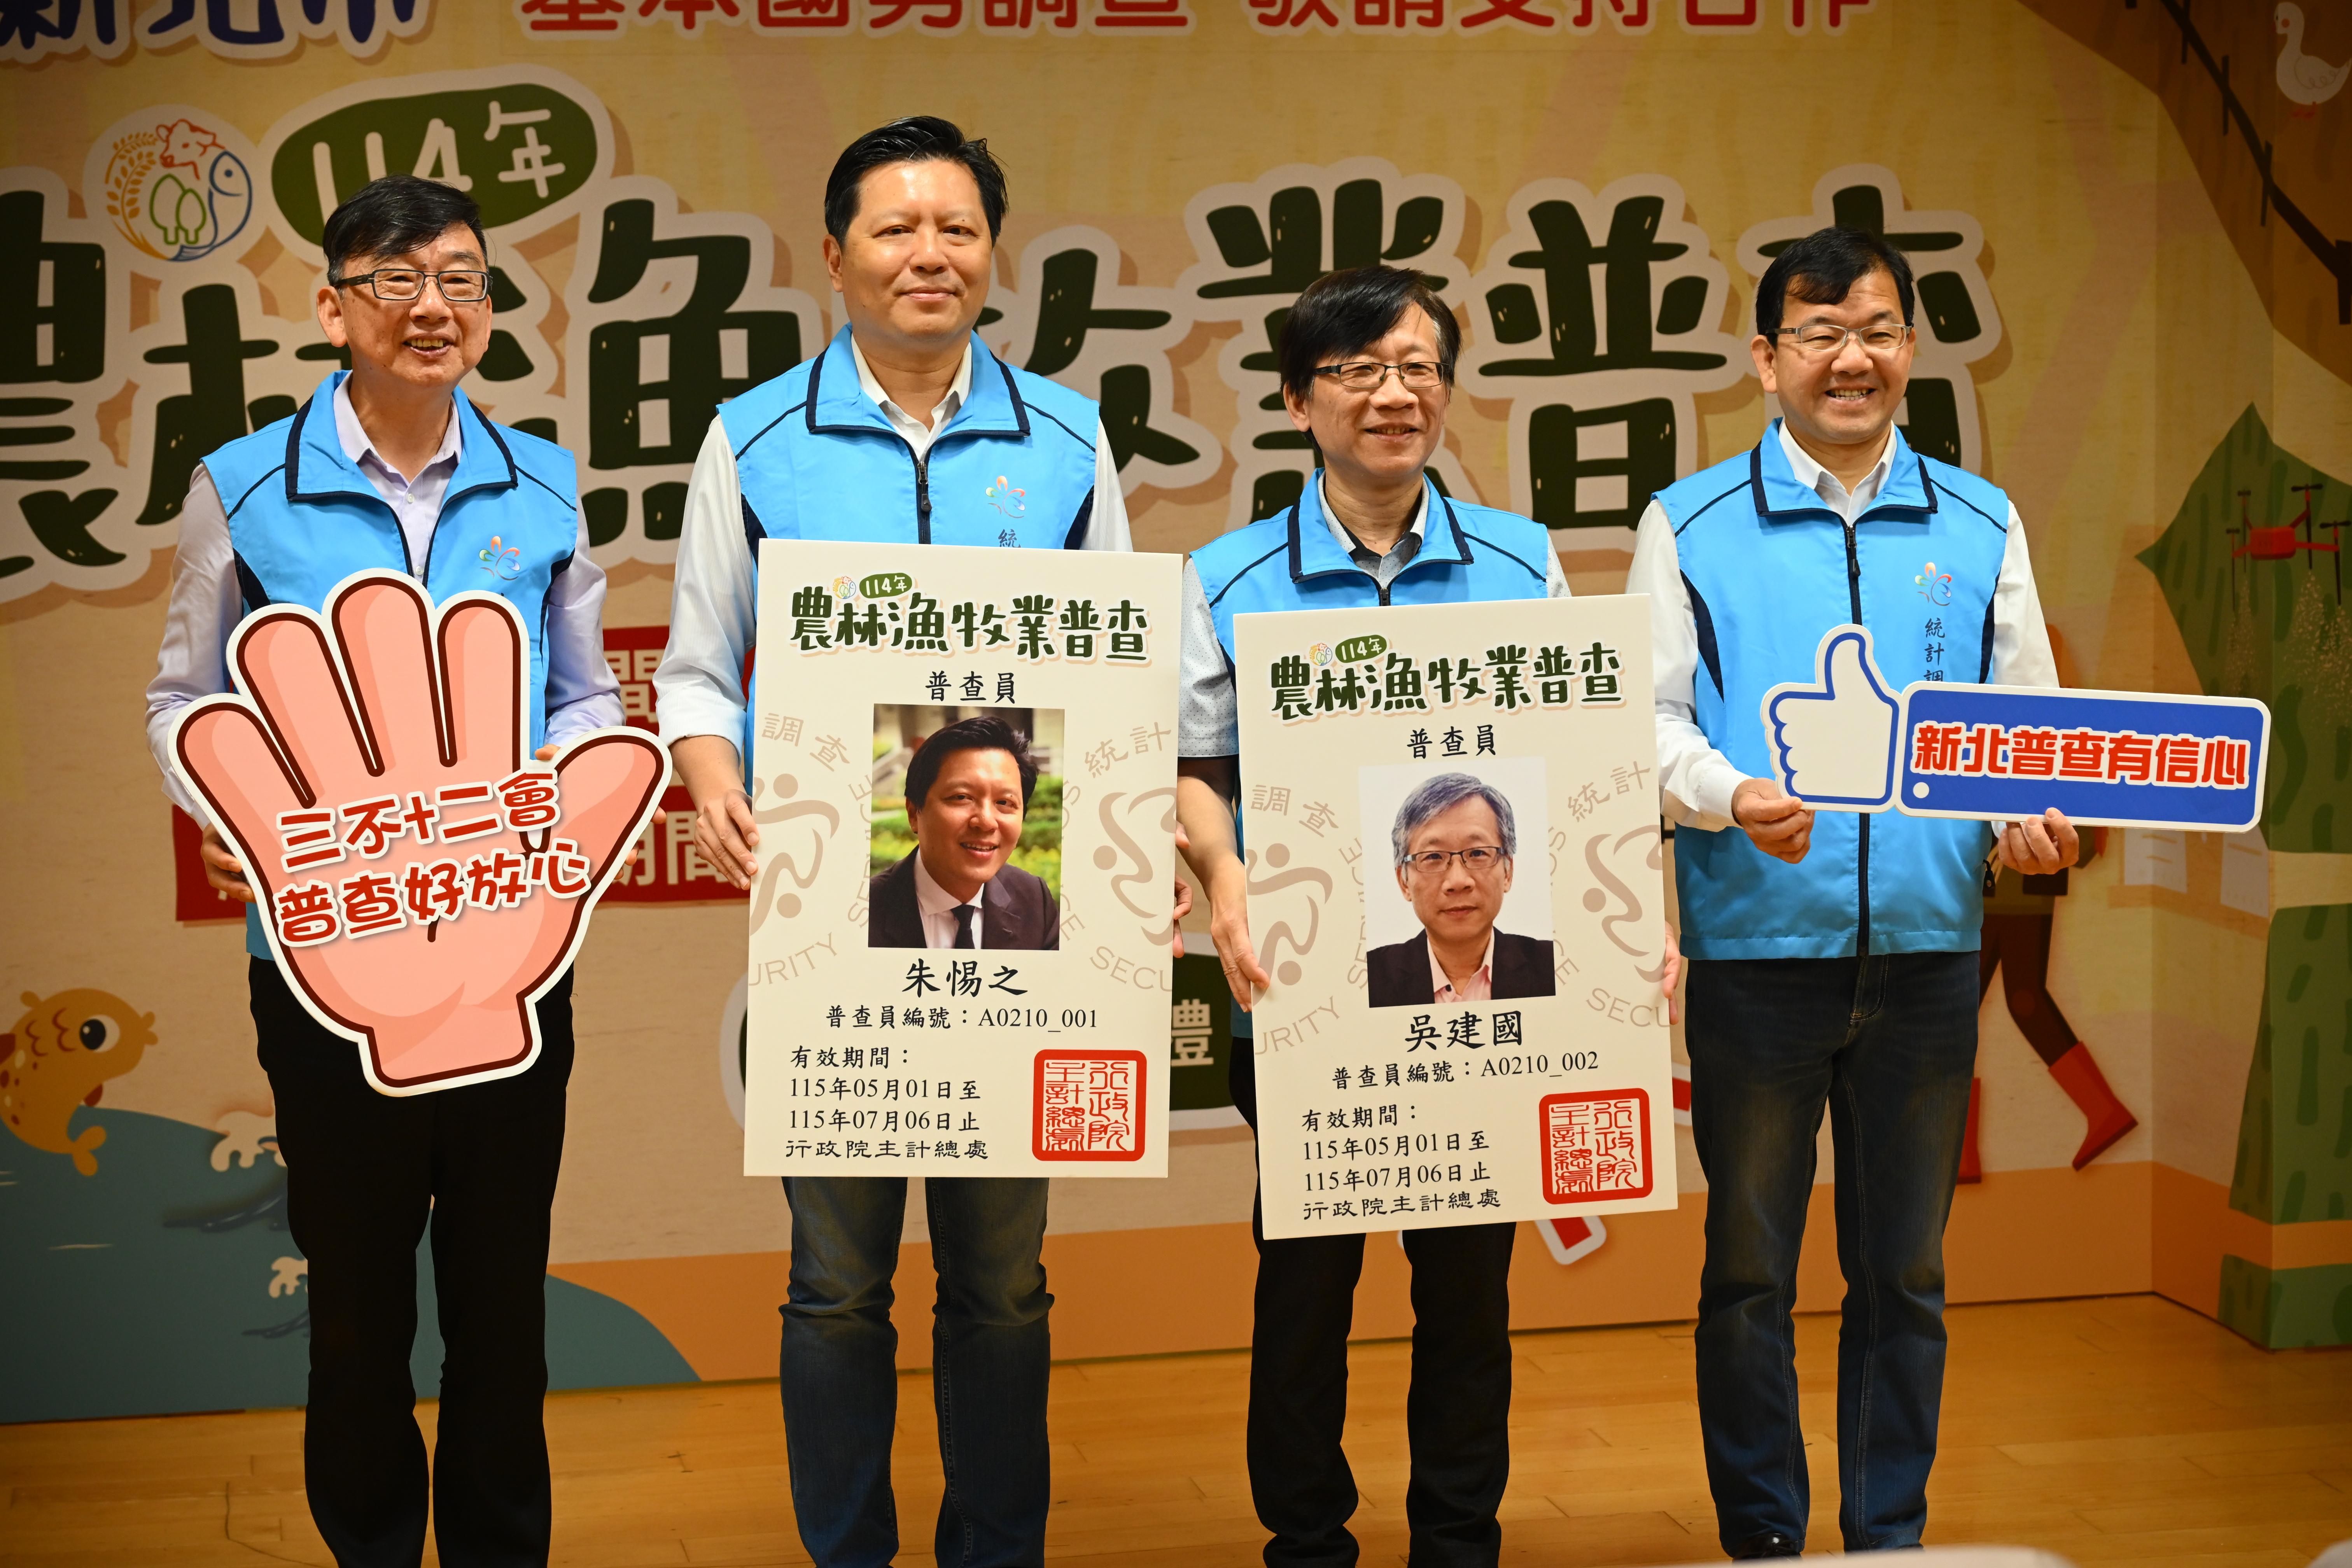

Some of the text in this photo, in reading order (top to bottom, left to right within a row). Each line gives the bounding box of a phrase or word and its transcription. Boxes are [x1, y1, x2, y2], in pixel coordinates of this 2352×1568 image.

[998, 529, 1021, 548] 統
[866, 575, 907, 596] 114年
[791, 586, 1146, 660] 農林漁牧業普查
[1342, 637, 1382, 660] 114年
[926, 671, 1015, 704] 普查員
[1271, 642, 1621, 720] 農林漁牧業普查
[761, 713, 850, 772] 調查
[1085, 722, 1171, 778] 統計
[1407, 725, 1495, 759] 普查員
[1914, 724, 2247, 786] 新北普查有信心
[1568, 761, 1651, 822] 統計
[282, 773, 556, 867] 三不十二會
[1251, 784, 1339, 838] 調查
[278, 843, 586, 942] 普查好放心
[902, 958, 1028, 998] 朱惕之
[1405, 1010, 1522, 1052] 吳建國
[791, 1045, 908, 1069] 有效期間：
[792, 1077, 981, 1101] 115年05月01日至
[791, 1109, 980, 1132] 115年07月06日止
[1302, 1104, 1416, 1132] 有效期間：
[786, 1139, 988, 1159] 行政院主計總處
[1304, 1130, 1489, 1161] 115年05月01日至
[1306, 1161, 1491, 1192] 115年07月06日止
[1303, 1188, 1501, 1220] 行政院主計總處
